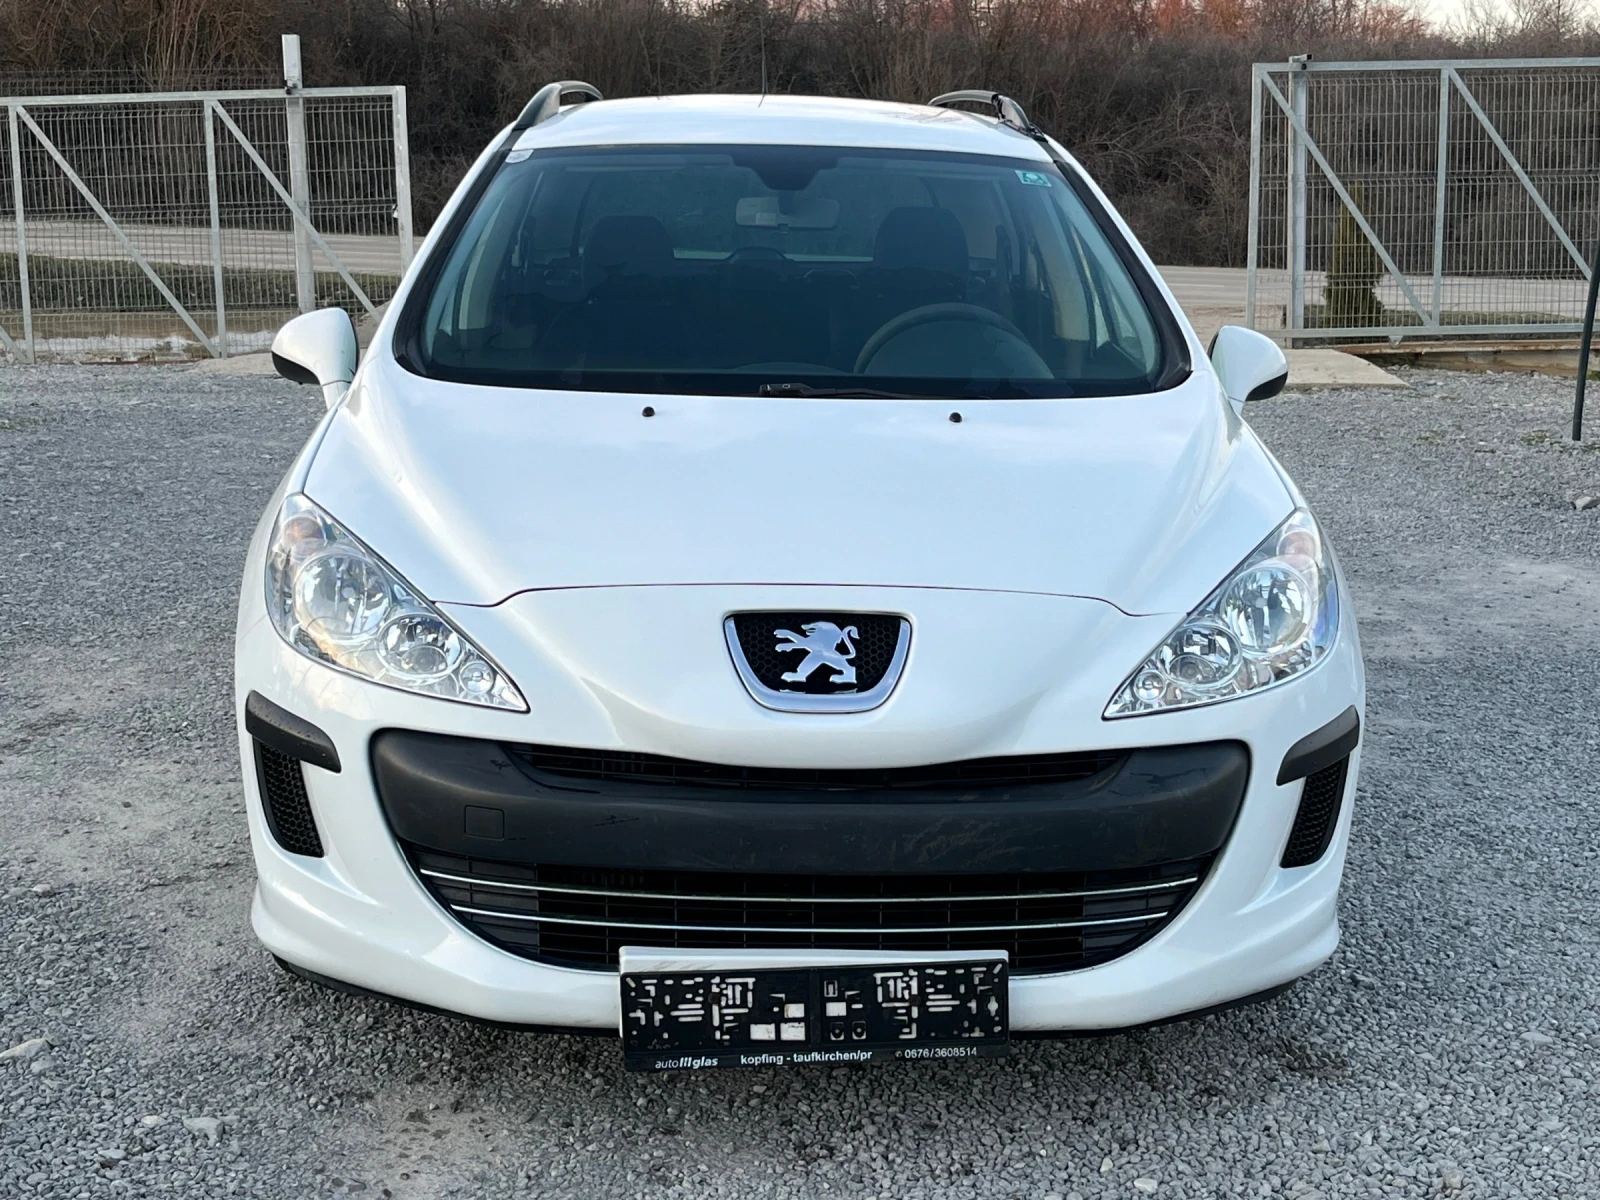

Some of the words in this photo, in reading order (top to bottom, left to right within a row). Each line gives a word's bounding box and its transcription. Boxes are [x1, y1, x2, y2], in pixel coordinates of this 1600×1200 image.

[741, 1053, 783, 1066] kopfing
[793, 1050, 872, 1062] taufkirchen/pr
[904, 1047, 977, 1059] 0676/3608514
